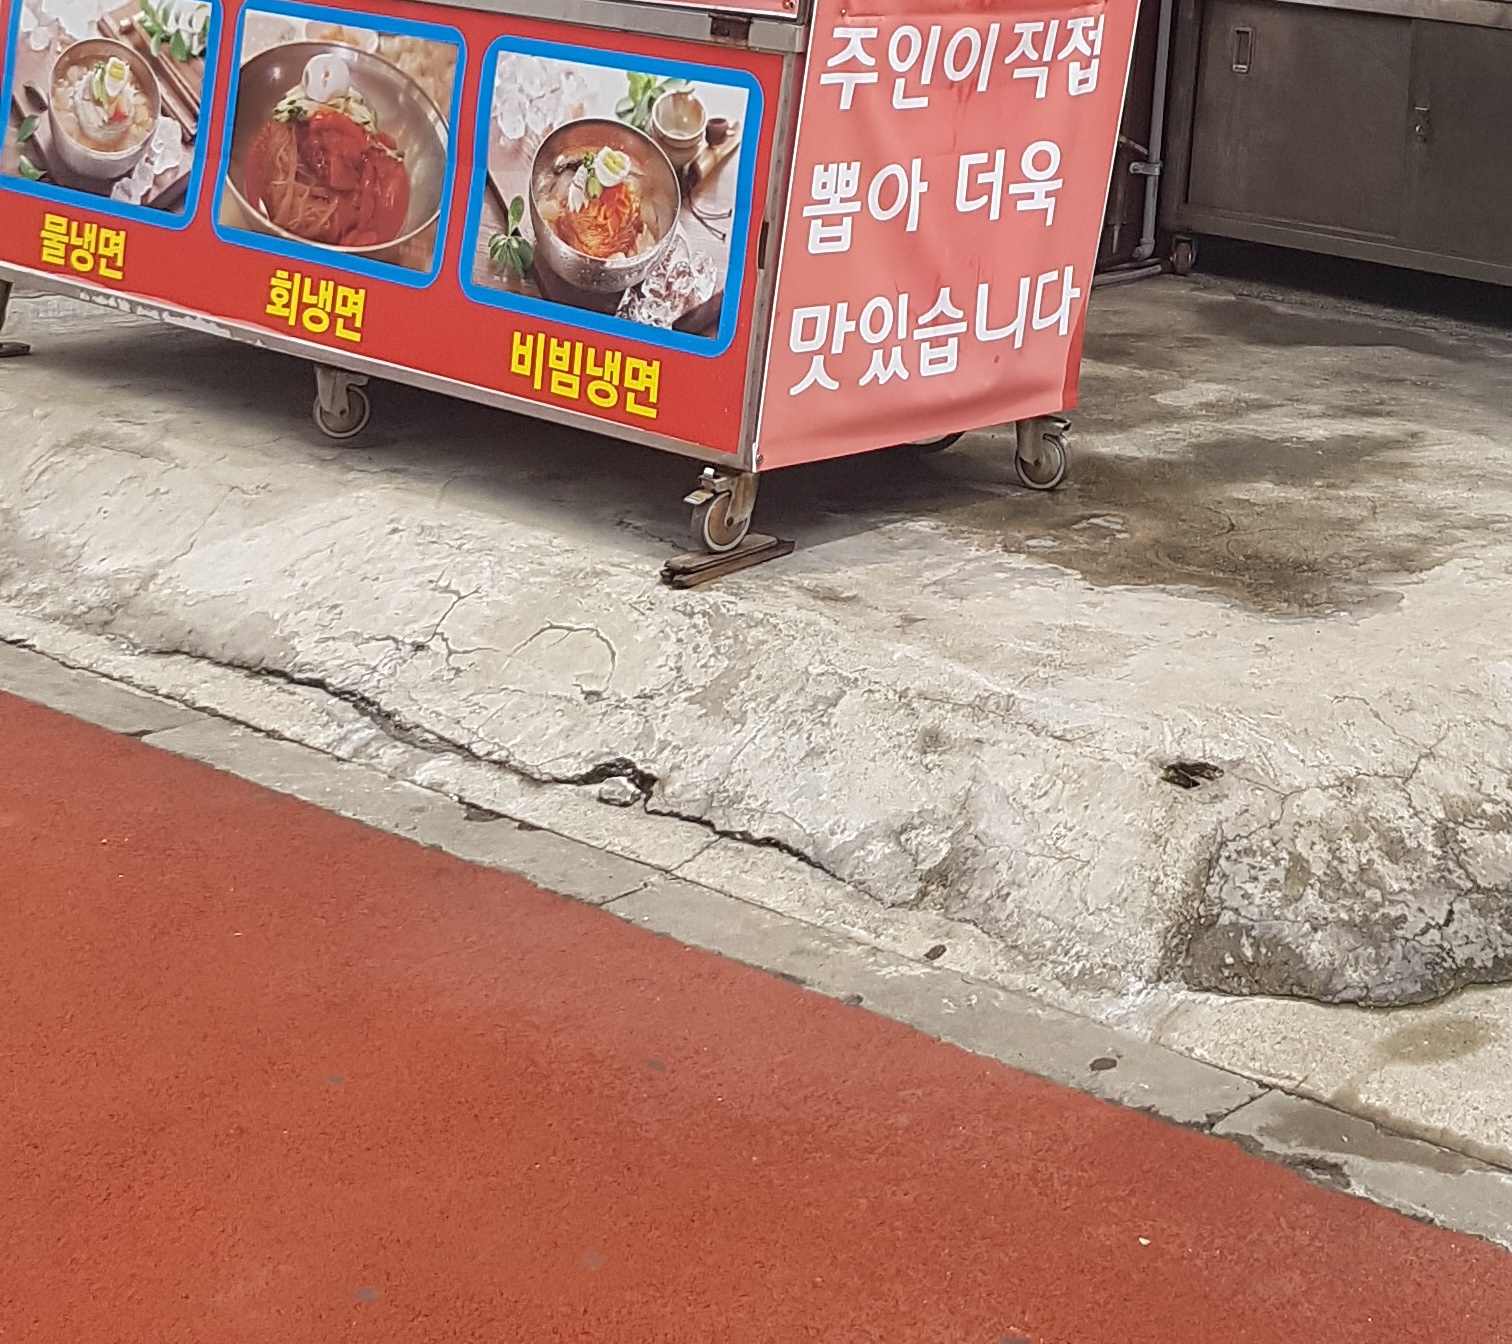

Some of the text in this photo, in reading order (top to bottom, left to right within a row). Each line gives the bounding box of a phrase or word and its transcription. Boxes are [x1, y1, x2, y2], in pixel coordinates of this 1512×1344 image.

[801, 139, 1066, 256] 뽑아 더욱
[39, 214, 127, 282] 물냉면
[264, 269, 367, 344] 회냉면
[788, 265, 1082, 397] 맛있습니다
[509, 330, 662, 420] 비빔냉면
